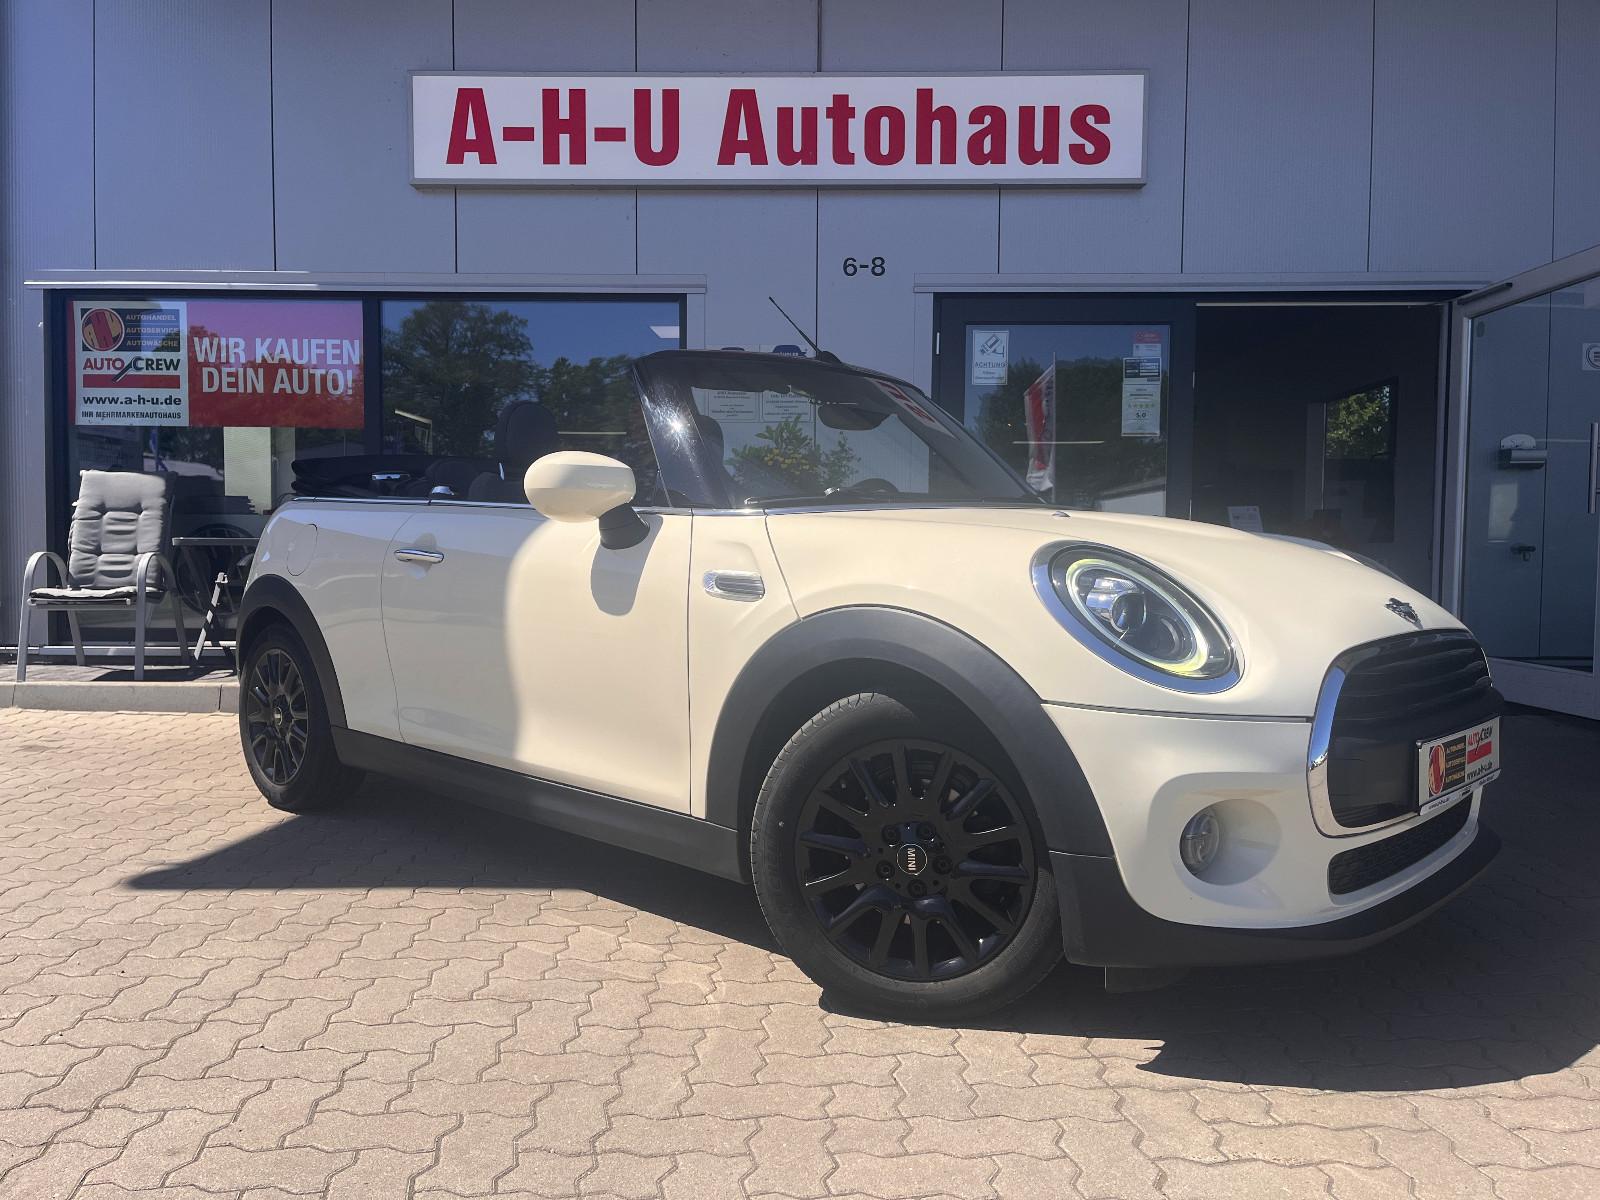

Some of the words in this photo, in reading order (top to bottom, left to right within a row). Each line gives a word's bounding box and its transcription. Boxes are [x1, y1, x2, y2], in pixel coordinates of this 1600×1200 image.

[446, 88, 680, 165] A-H-U
[719, 88, 1110, 165] Autohaus
[843, 256, 886, 277] 6-8
[193, 337, 246, 364] WIR
[255, 337, 360, 365] KAUFEN
[83, 357, 125, 371] AUTO
[132, 356, 182, 371] CREW
[202, 367, 265, 394] DEIN
[273, 368, 353, 395] AUTO!
[82, 394, 182, 406] www.a-h-u.de
[82, 411, 94, 419] IHR
[95, 411, 182, 419] MEHRMARKENAUTOHAUS
[907, 848, 917, 870] MINI
